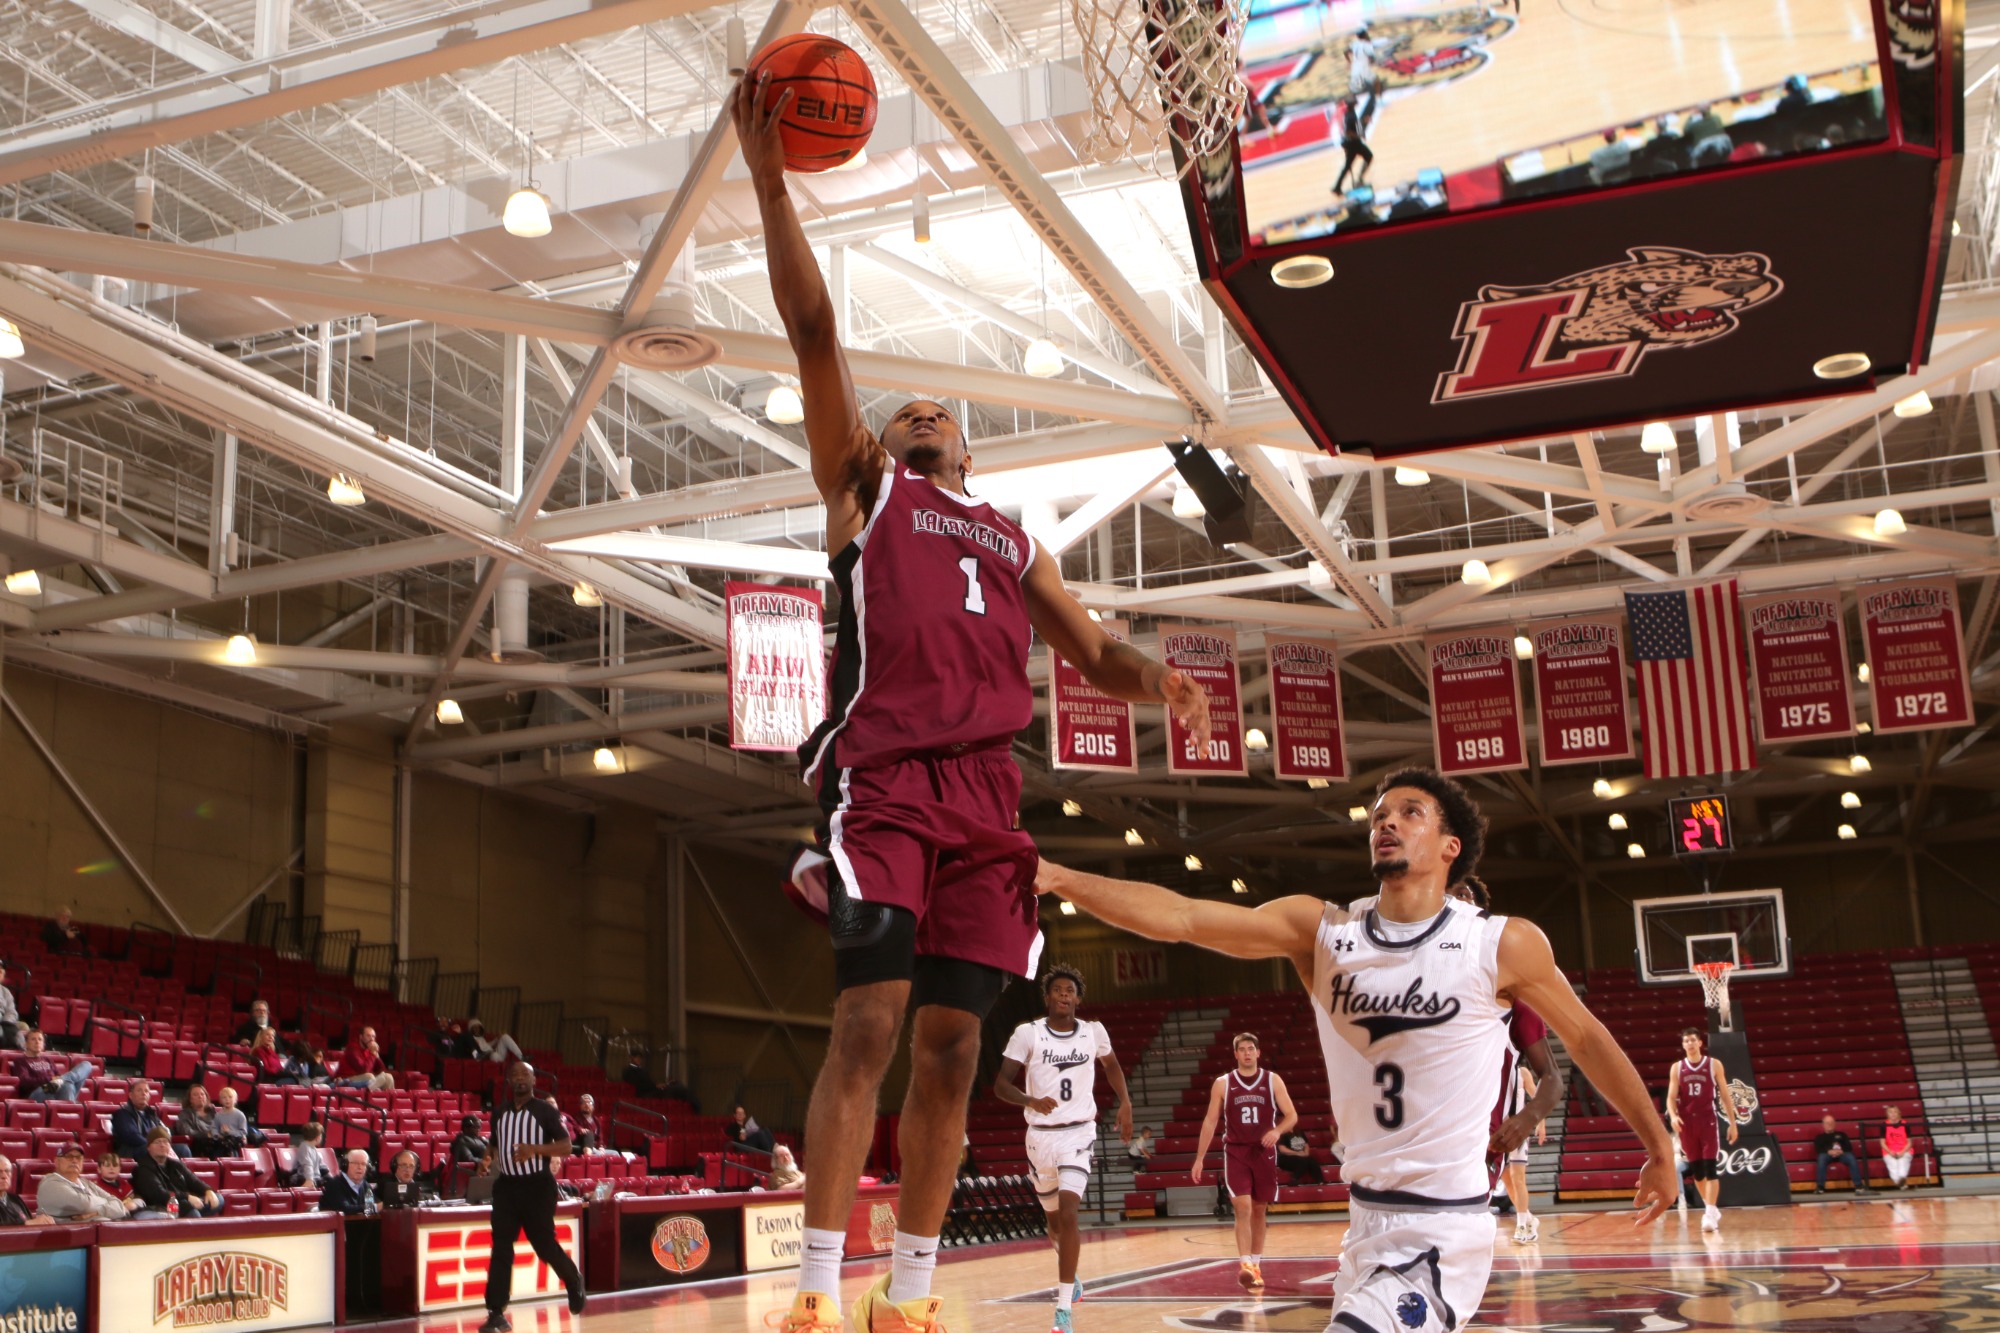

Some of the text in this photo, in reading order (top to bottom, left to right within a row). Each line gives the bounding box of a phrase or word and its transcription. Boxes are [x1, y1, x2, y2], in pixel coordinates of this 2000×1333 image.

[796, 96, 866, 126] ELITE
[1430, 287, 1641, 404] L
[911, 509, 1019, 565] LAFAYETTE
[957, 556, 987, 615] 1
[732, 595, 816, 622] LAFAYETTE
[1865, 588, 1952, 615] LAFAYETTE
[1751, 600, 1835, 627] LAFAYETTE
[1765, 617, 1825, 633] LEOPARDS
[1877, 620, 1947, 635] MEN'S BASKETBALL
[1536, 625, 1617, 650] LAFAYETTE
[1762, 632, 1831, 647] MEN'S BASKETBALL
[1165, 635, 1233, 659] LAFAYETTE
[1271, 644, 1334, 667] LAFAYETTE
[1432, 638, 1510, 663] LAFAYETTE
[1549, 641, 1605, 656] LEOPARDS
[1886, 640, 1943, 657] NATIONAL
[746, 653, 806, 678] AIAW
[1176, 652, 1223, 664] LEOPARDS
[1444, 654, 1499, 669] LEOPARDS
[1546, 656, 1611, 670] MEN'S BASKETBALL
[1771, 652, 1827, 668] NATIONAL
[1883, 655, 1949, 672] INVITATION
[1192, 669, 1229, 679] BASKETBALL
[1282, 661, 1325, 674] LEOPARDS
[1441, 668, 1505, 682] MEN'S BASKETBALL
[1768, 666, 1832, 683] INVITATION
[1280, 677, 1330, 687] MEN'S BASKETBALL
[1554, 676, 1607, 691] NATIONAL
[1878, 668, 1957, 687] TOURNAMENT
[739, 680, 816, 700] PLAYOFFS
[1063, 686, 1109, 698] TOURNAM
[1295, 691, 1317, 701] NCAA
[1551, 690, 1612, 705] INVITATION
[1763, 680, 1841, 698] TOURNAMENT
[1059, 701, 1127, 716] PATRIOT LEAGUE
[1281, 701, 1332, 713] TOURNAMENT
[1441, 696, 1511, 712] PATRIOT LEAGUE
[1546, 703, 1620, 720] TOURNAMENT
[1894, 691, 1949, 717] 1972
[1069, 714, 1118, 726] CHAMPIONS
[1211, 711, 1237, 722] EAGUE
[1278, 715, 1338, 729] PATRIOT LEAGUE
[1441, 707, 1513, 723] REGULAR SEASON
[1779, 702, 1832, 728] 1975
[1288, 728, 1331, 739] CHAMPIONS
[1454, 720, 1502, 733] CHAMPIONS
[1074, 732, 1117, 757] 2015
[1560, 725, 1610, 750] 1980
[1185, 739, 1230, 761] 200
[1292, 745, 1331, 767] 1999
[1456, 736, 1505, 761] 1998
[1683, 817, 1722, 850] 27
[1439, 942, 1462, 950] CAA
[1330, 974, 1461, 1018] Hawks
[1042, 1048, 1090, 1066] Hawks
[1060, 1078, 1072, 1102] 8
[1373, 1062, 1405, 1131] 3
[1687, 1083, 1702, 1096] 13
[1241, 1106, 1259, 1124] 21
[156, 1254, 286, 1318] LAFAYETTE
[174, 1298, 270, 1326] MAROON CLUB
